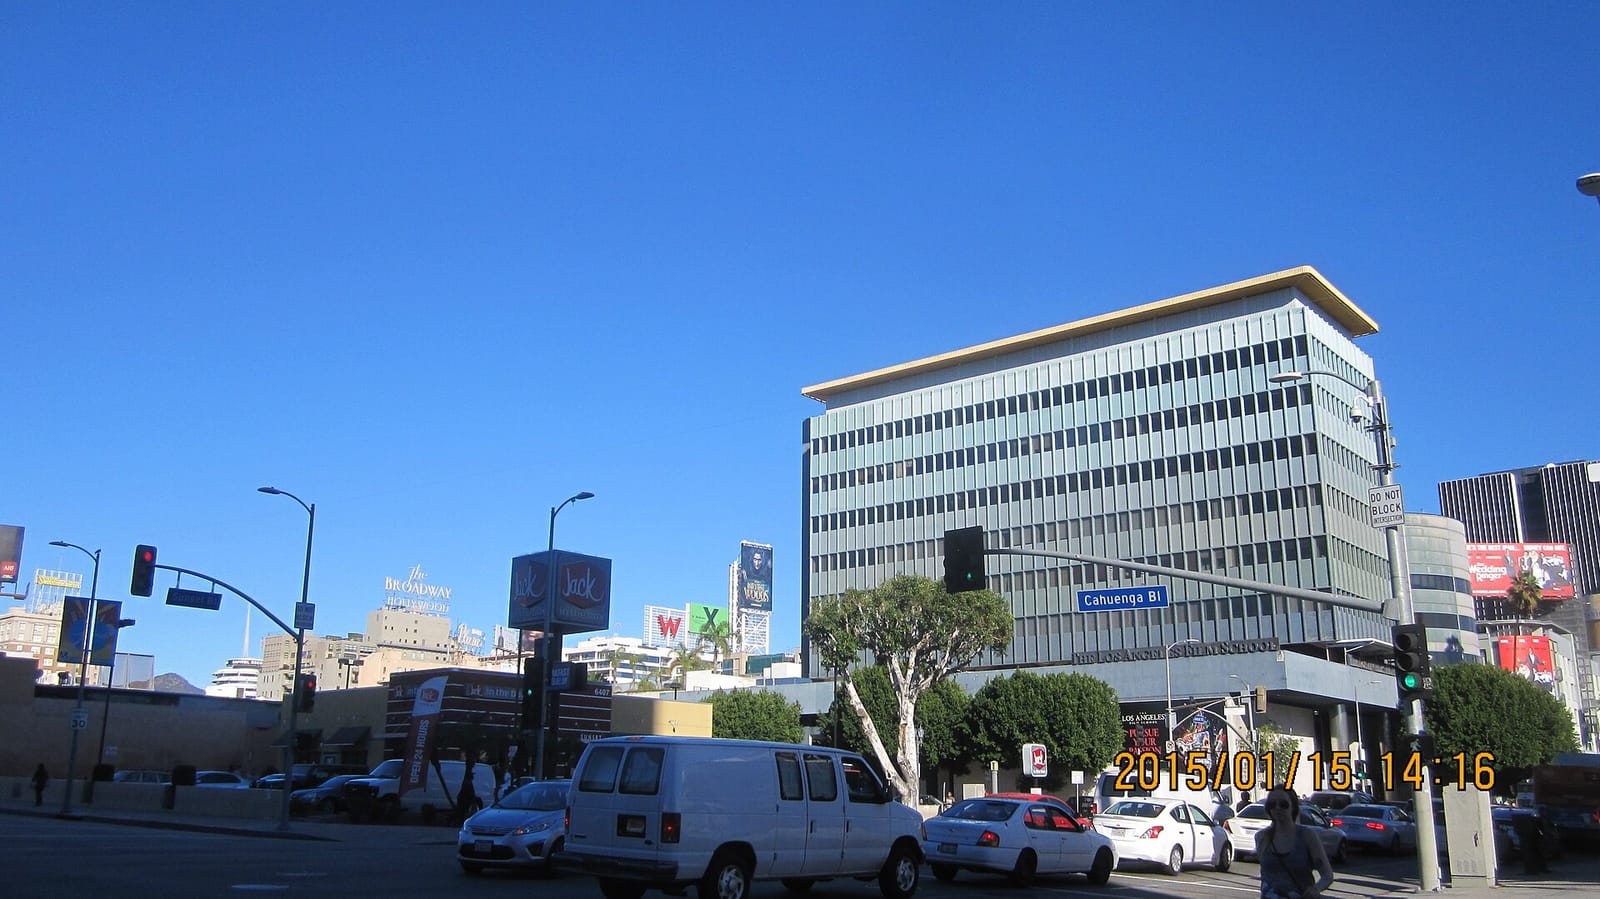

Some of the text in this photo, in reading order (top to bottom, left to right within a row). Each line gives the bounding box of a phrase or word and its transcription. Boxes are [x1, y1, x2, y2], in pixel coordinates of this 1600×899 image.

[1370, 490, 1400, 502] DO NOT
[1372, 503, 1401, 515] BLOCK
[1469, 564, 1508, 576] Wedding
[562, 567, 604, 602] Jack
[1477, 573, 1502, 582] Ringer
[385, 576, 451, 599] BROADWAY
[388, 596, 449, 612] HOLLYWOOD
[1084, 591, 1161, 606] Cahuenga Bl
[656, 614, 682, 638] W
[703, 606, 719, 632] X
[1072, 638, 1276, 665] THE LOS ANGELES FILM SCHOOL
[594, 689, 611, 697] 6407
[72, 720, 86, 728] 30
[1122, 713, 1166, 722] LOS ANGELES
[416, 719, 430, 748] HOURS
[1129, 728, 1159, 737] PUSUE
[414, 748, 425, 761] 24
[410, 761, 423, 784] OPEN
